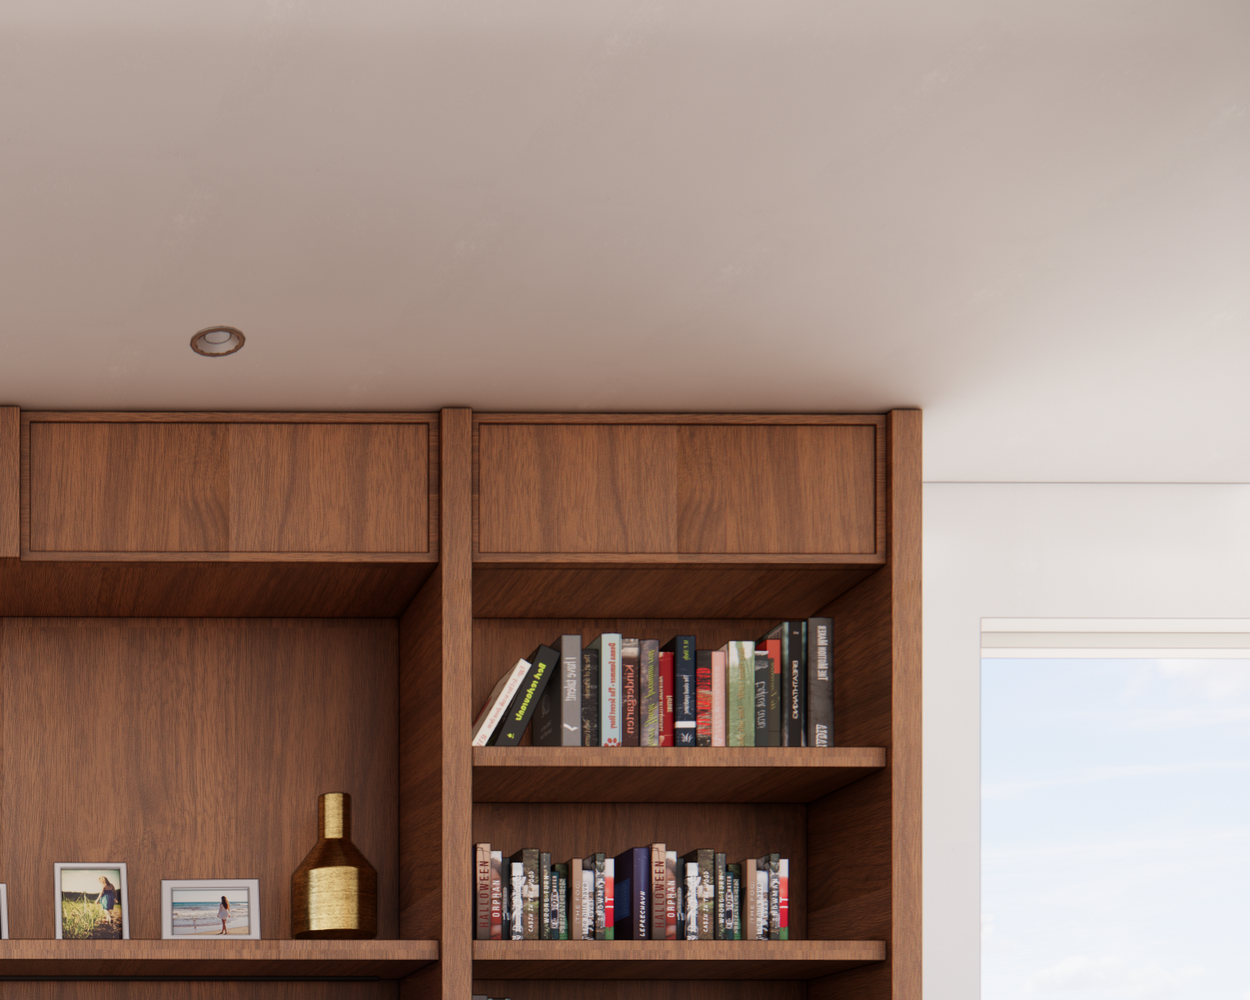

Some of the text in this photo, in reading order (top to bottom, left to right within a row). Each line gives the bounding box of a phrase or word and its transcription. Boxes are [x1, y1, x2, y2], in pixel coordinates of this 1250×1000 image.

[479, 861, 489, 927] HALLOWEEN
[492, 880, 500, 917] ORPHAN
[606, 896, 614, 908] IT
[655, 861, 664, 928] HALLOWEEN
[667, 880, 675, 917] ORPHAN
[780, 897, 788, 908] IT
